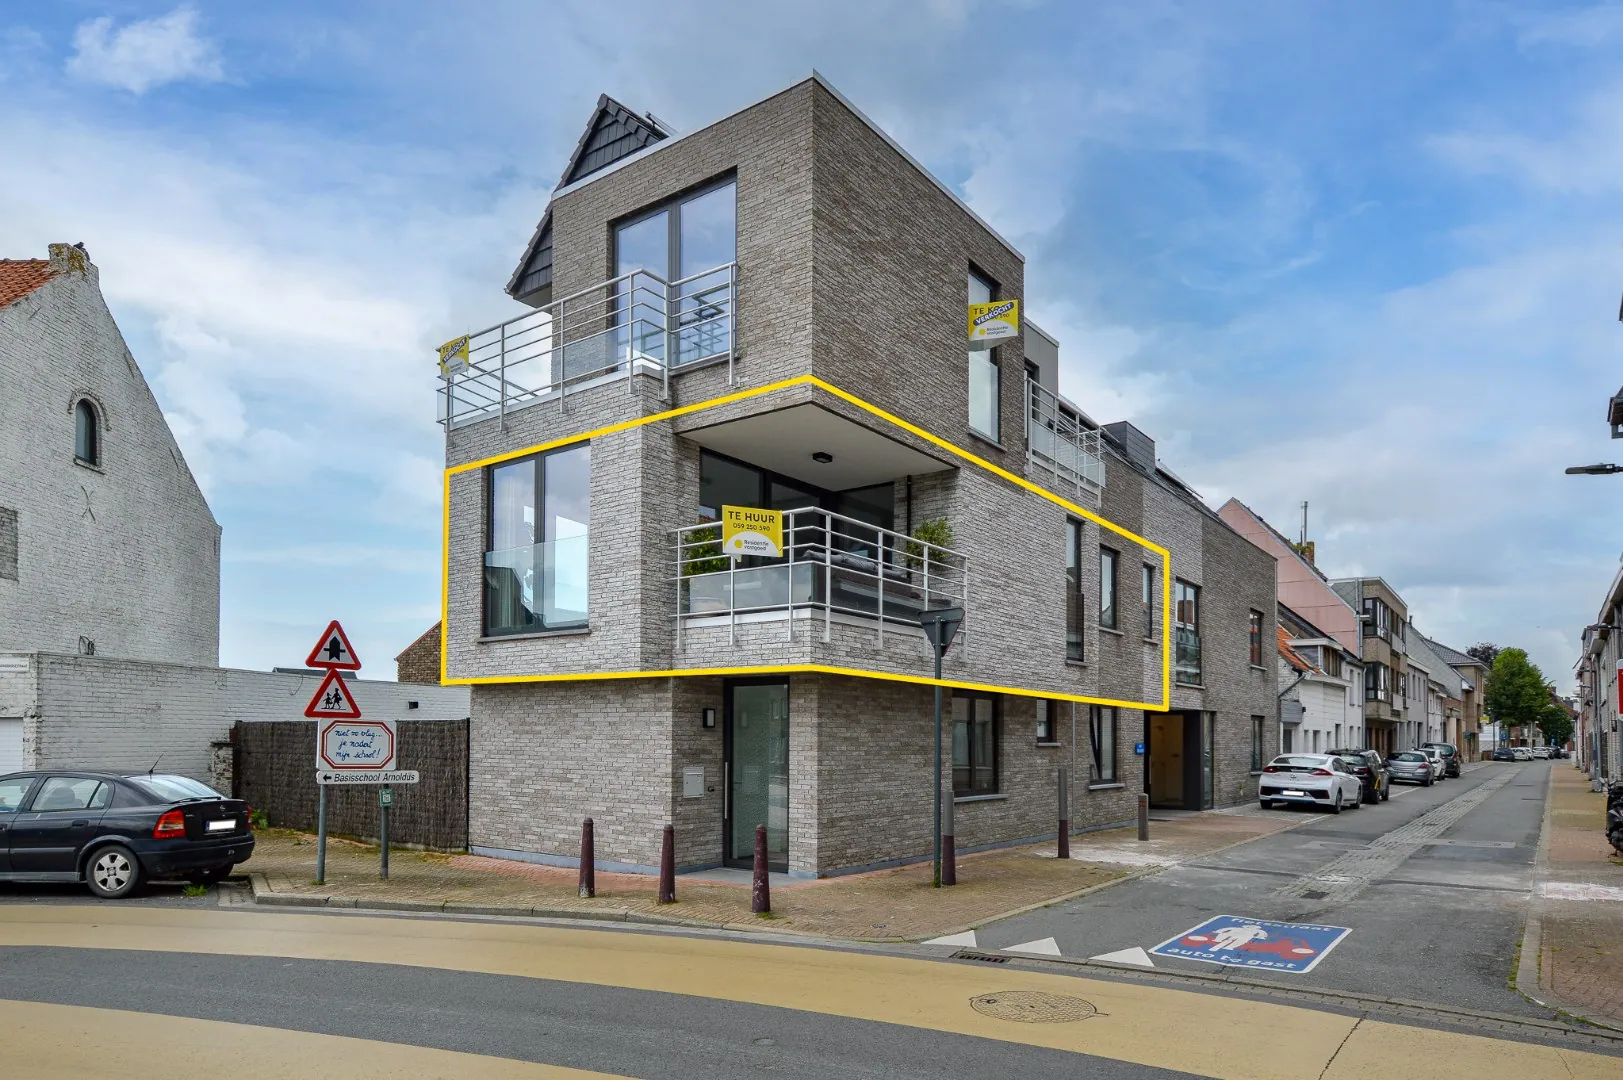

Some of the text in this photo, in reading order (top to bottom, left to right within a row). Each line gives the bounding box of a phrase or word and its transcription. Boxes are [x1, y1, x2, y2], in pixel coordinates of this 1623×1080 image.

[973, 307, 984, 315] TE
[975, 303, 1011, 324] VERKOCHT
[728, 510, 775, 523] TE HUUR
[334, 773, 415, 782] Basisschool Arnoldus
[1167, 948, 1214, 958] auto
[1247, 959, 1297, 968] gast
